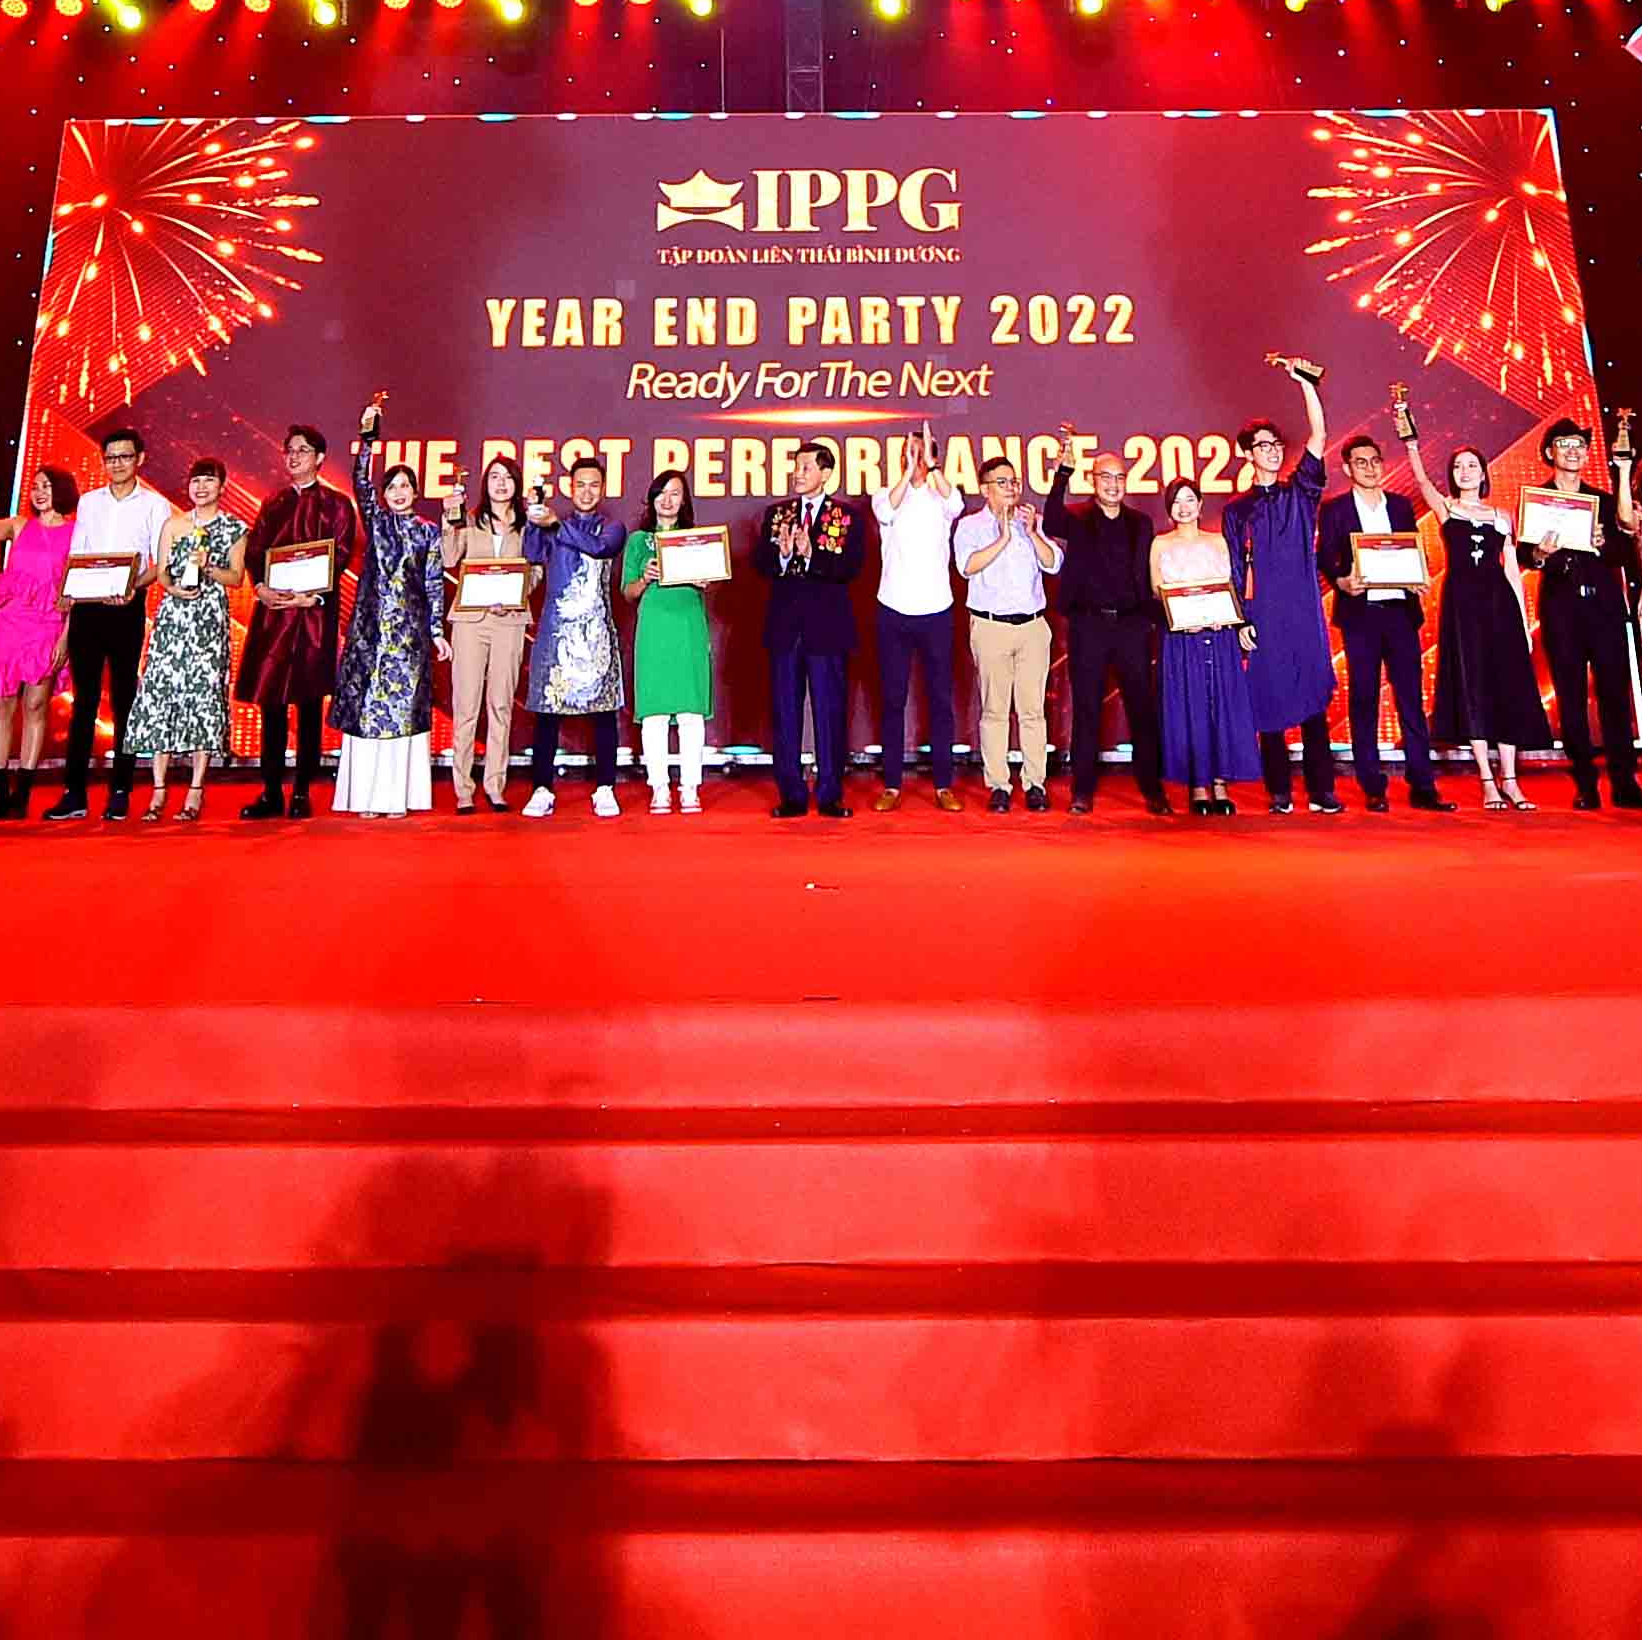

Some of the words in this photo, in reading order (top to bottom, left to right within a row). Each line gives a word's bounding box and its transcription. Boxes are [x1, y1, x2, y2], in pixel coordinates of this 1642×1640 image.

[751, 167, 962, 232] IPPG
[656, 245, 693, 267] TẬP
[752, 244, 794, 264] LIÊN
[795, 244, 842, 264] THÁI
[845, 244, 891, 264] BÌNH
[893, 244, 962, 264] DƯƠNG
[485, 297, 624, 347] YEAR
[653, 297, 757, 346] END
[787, 296, 962, 345] PARTY
[989, 294, 1135, 344] 2022
[625, 361, 751, 408] Ready
[754, 362, 818, 399] For
[819, 360, 892, 397] The
[898, 360, 994, 397] Next
[653, 434, 1098, 497] PERFORANCE
